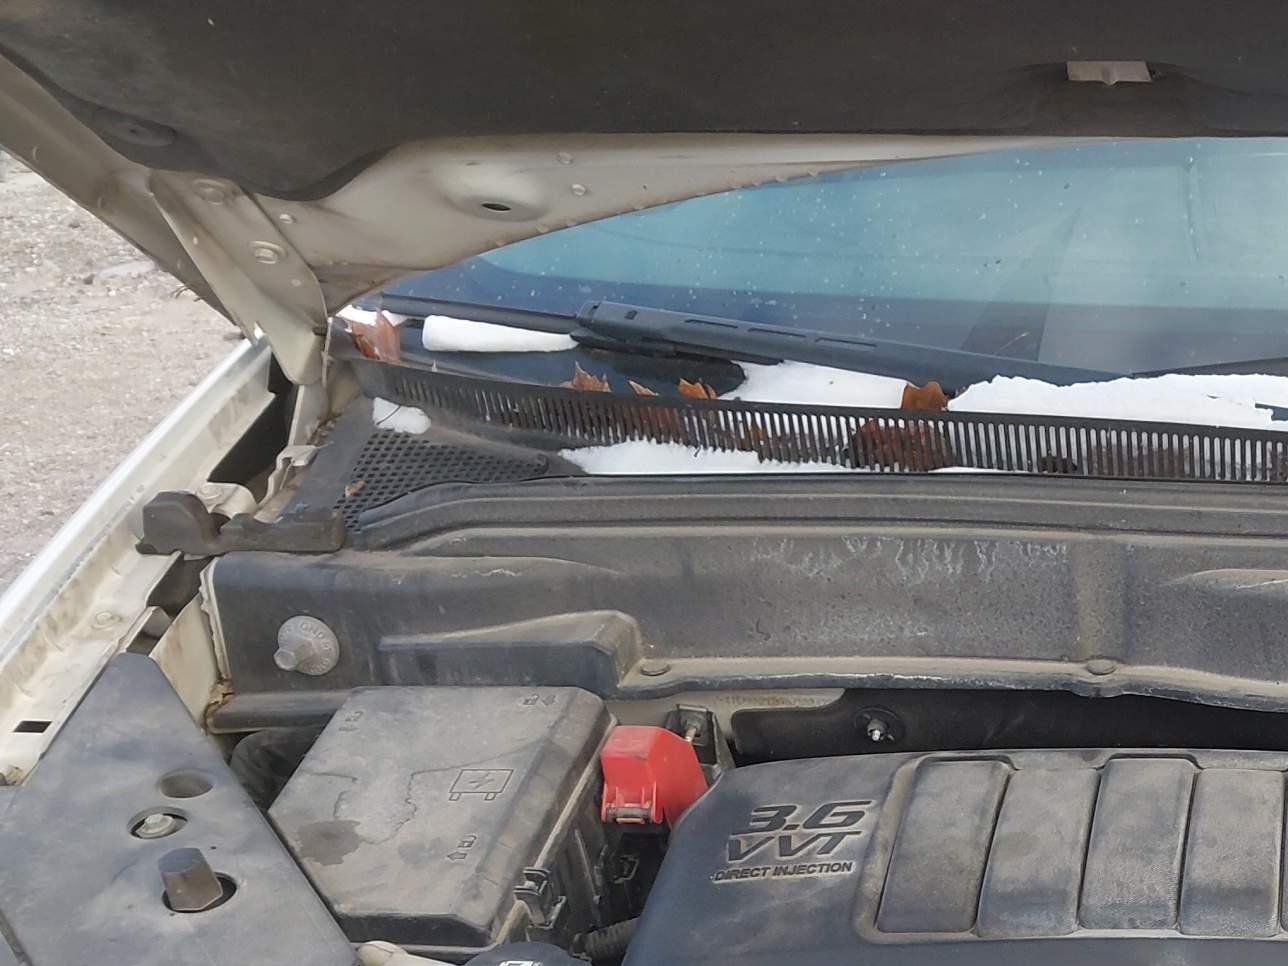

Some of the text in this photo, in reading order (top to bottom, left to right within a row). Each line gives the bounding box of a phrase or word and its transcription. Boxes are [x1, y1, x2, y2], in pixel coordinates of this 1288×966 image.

[731, 800, 874, 835] 3.6
[728, 830, 863, 862] VVT
[713, 862, 854, 881] DIRECT INJECTION
